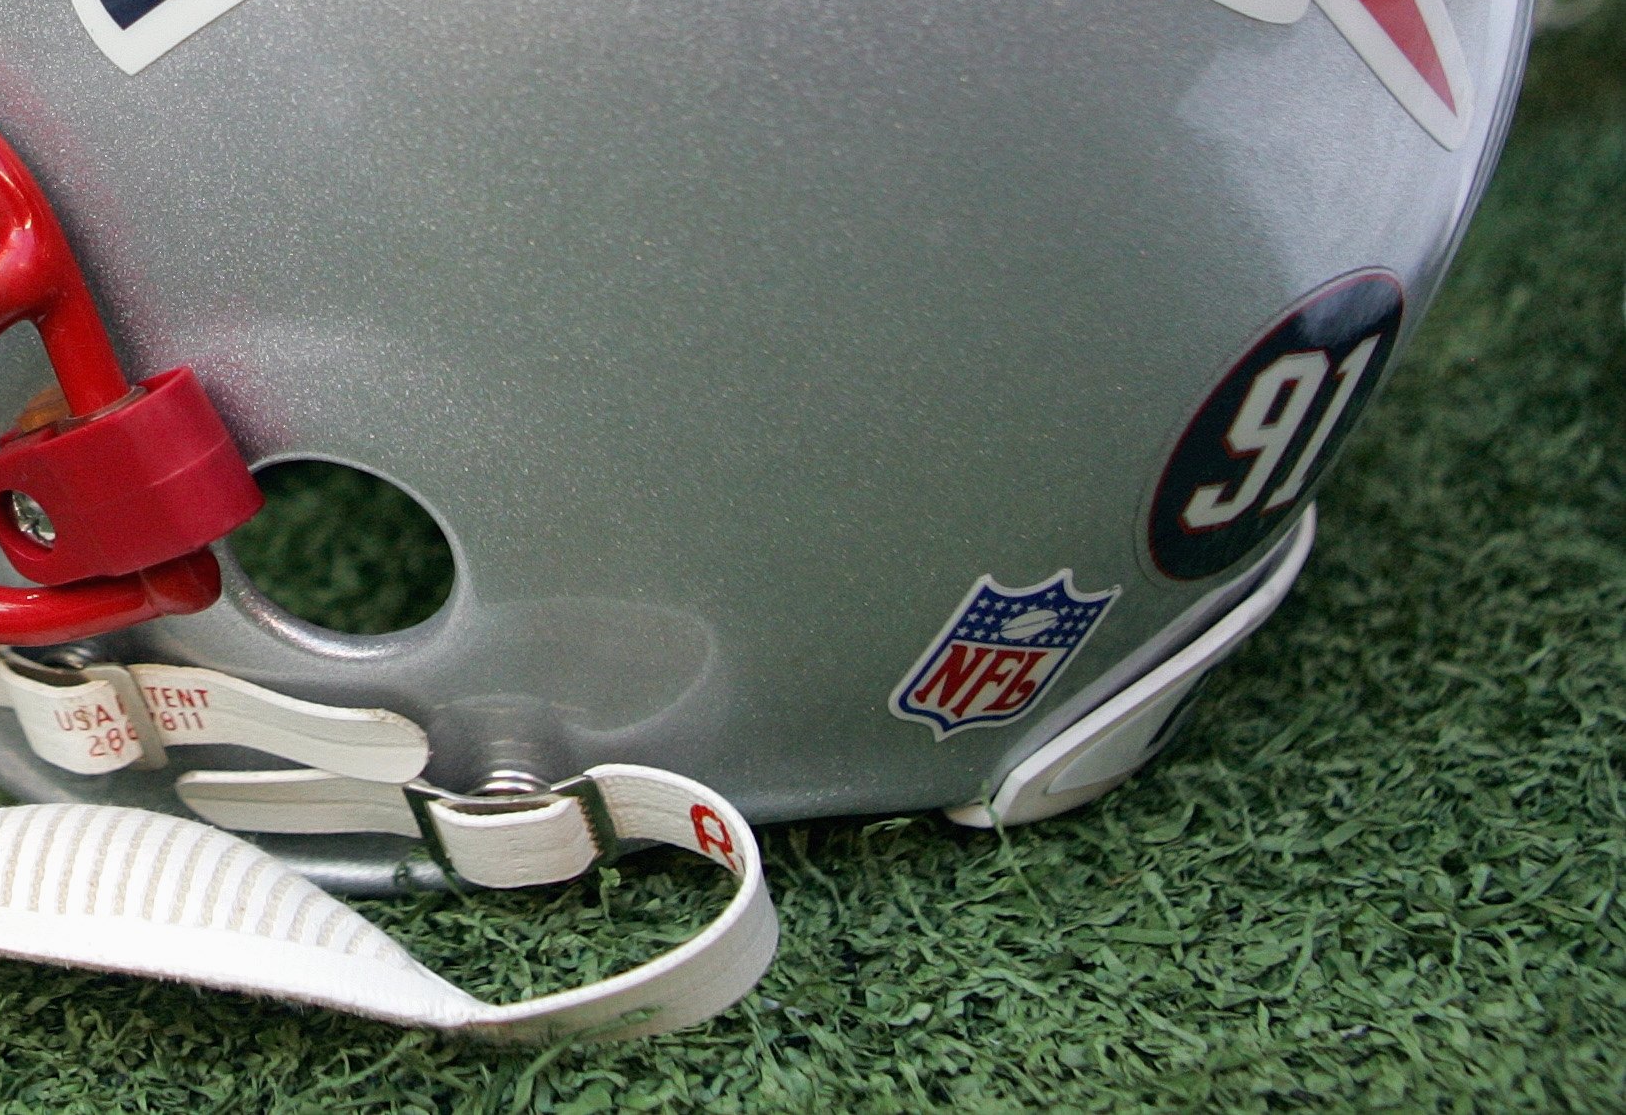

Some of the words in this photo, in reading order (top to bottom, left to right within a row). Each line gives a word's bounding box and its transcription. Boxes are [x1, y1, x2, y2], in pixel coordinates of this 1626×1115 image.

[1178, 332, 1382, 534] 91
[53, 704, 113, 732] USA
[914, 644, 1049, 718] NFL
